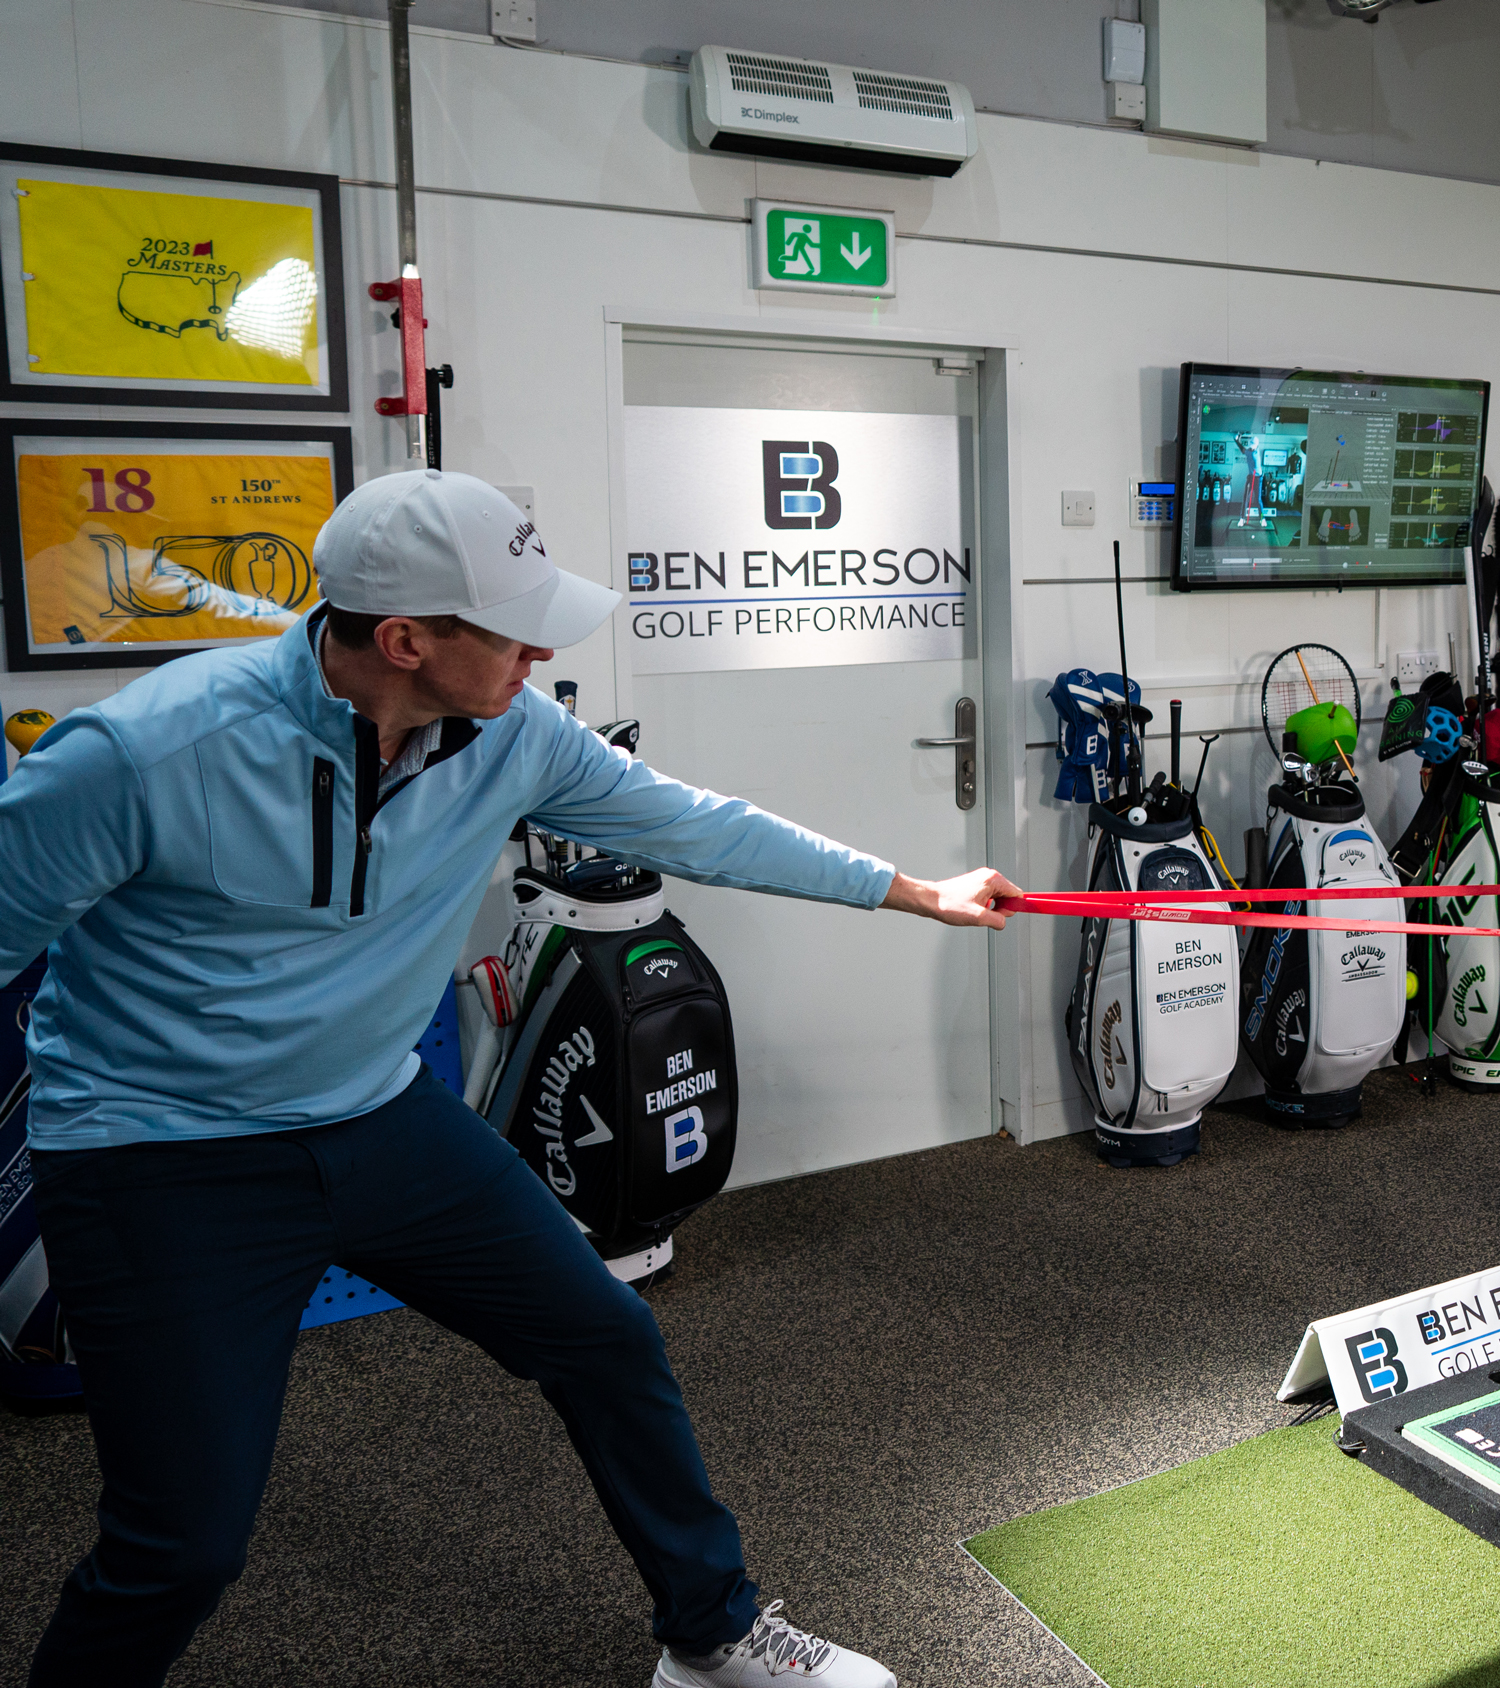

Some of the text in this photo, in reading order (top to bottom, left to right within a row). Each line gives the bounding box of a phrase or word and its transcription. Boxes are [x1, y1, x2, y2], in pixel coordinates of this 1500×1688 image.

[754, 109, 799, 124] Dimplex
[141, 237, 190, 256] 2023
[82, 467, 155, 513] 18
[211, 496, 302, 504] ST ANDREWS
[628, 548, 971, 592] BEN EMERSON
[632, 602, 966, 639] GOLF PERFORMANCE
[1339, 849, 1367, 863] Callaway
[1157, 865, 1190, 880] Callaway
[1175, 939, 1202, 955] BEN
[1340, 945, 1386, 966] Callaway
[644, 958, 679, 977] Callaway
[1157, 952, 1223, 975] EMERSON
[1156, 991, 1177, 1004] BEN
[1178, 982, 1226, 999] EMERSON
[1454, 964, 1486, 1028] Callaway
[1160, 995, 1224, 1015] GOLF ACADEMY
[1275, 988, 1306, 1057] Callaway
[1100, 999, 1122, 1090] Callaway
[666, 1048, 693, 1079] BEN
[1451, 1062, 1476, 1076] EPIC
[645, 1069, 717, 1115] EMERSON
[534, 1026, 597, 1196] Callaway
[1416, 1294, 1488, 1346] BEN
[1438, 1341, 1498, 1379] GOLF
